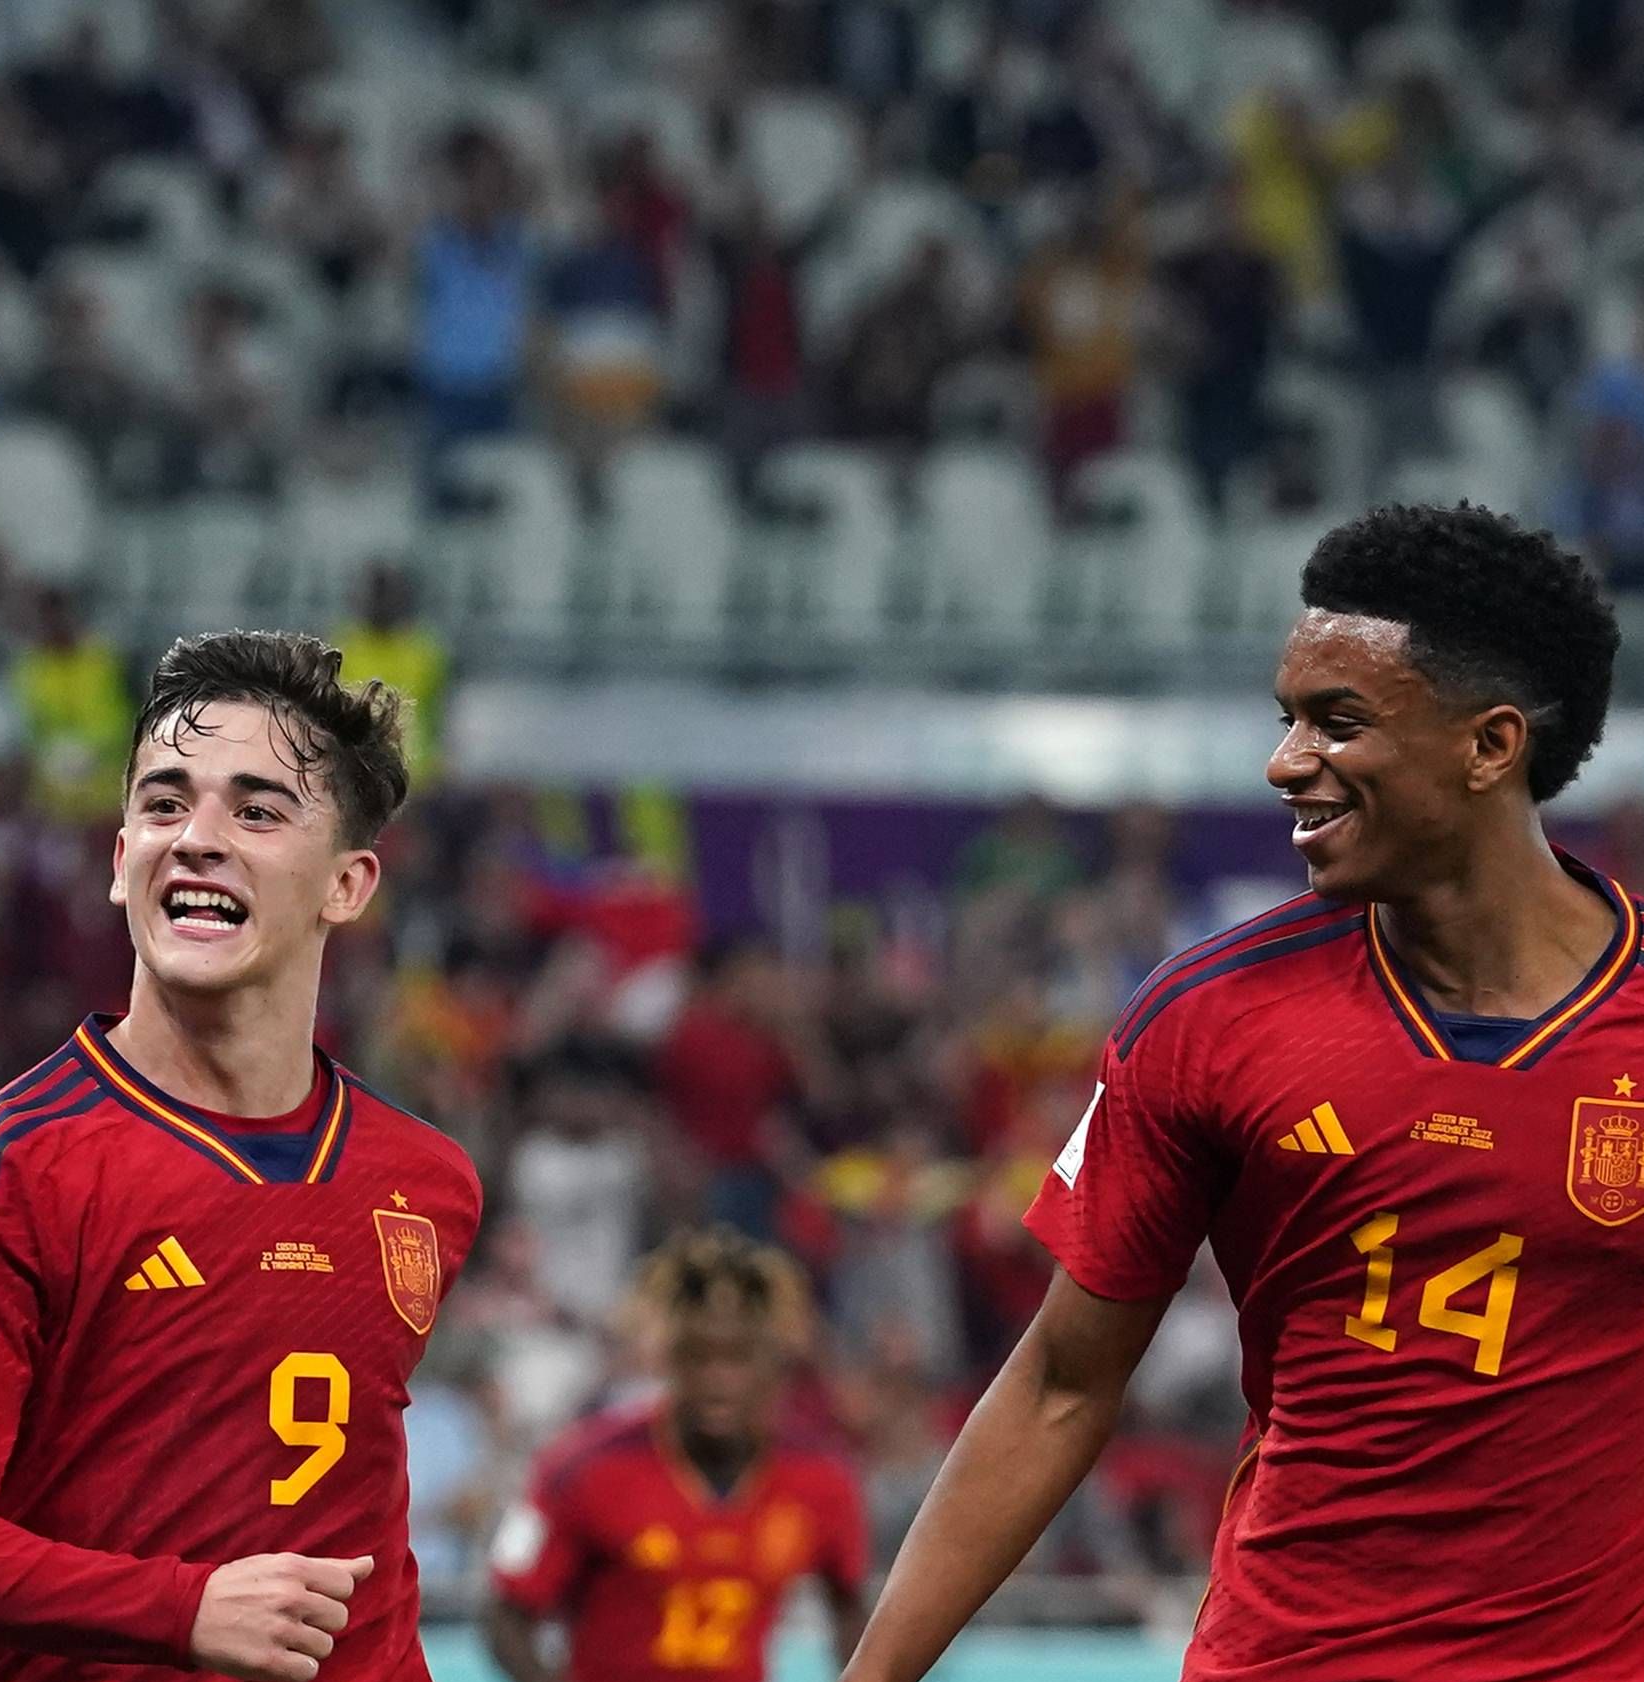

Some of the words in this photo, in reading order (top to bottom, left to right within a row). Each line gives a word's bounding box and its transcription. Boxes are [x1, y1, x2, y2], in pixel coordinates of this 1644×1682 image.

[1344, 1212, 1524, 1377] 14
[269, 1352, 351, 1506] 9
[654, 1577, 754, 1669] 12
